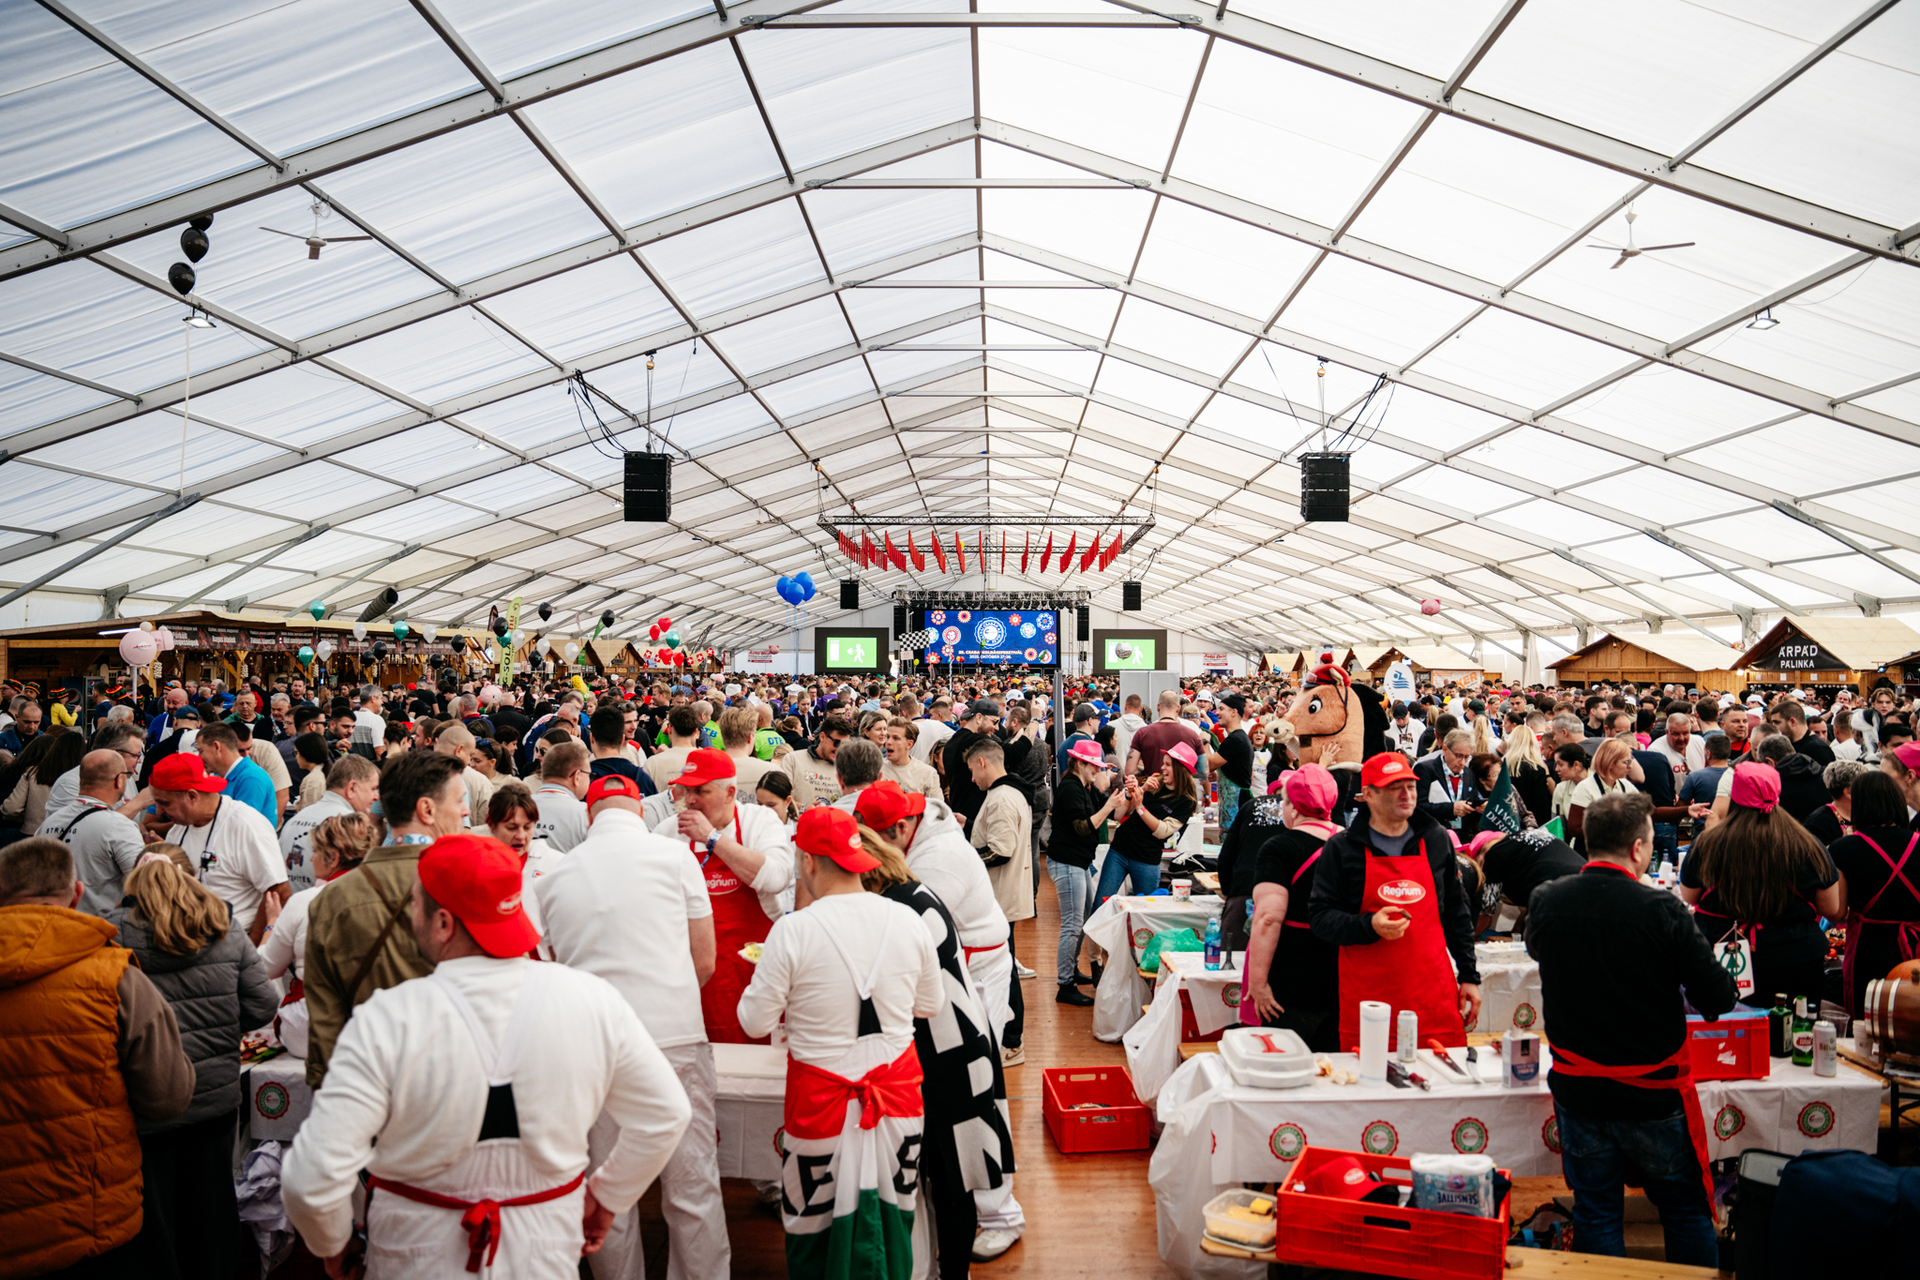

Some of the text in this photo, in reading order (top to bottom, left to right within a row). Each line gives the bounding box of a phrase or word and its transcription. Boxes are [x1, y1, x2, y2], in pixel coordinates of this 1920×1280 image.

[1778, 644, 1819, 658] ÁRPÁD
[1780, 659, 1815, 669] PÁLINKA
[706, 877, 738, 889] egnum
[1383, 885, 1422, 899] Regnum
[1436, 1190, 1479, 1205] SENSITIVE
